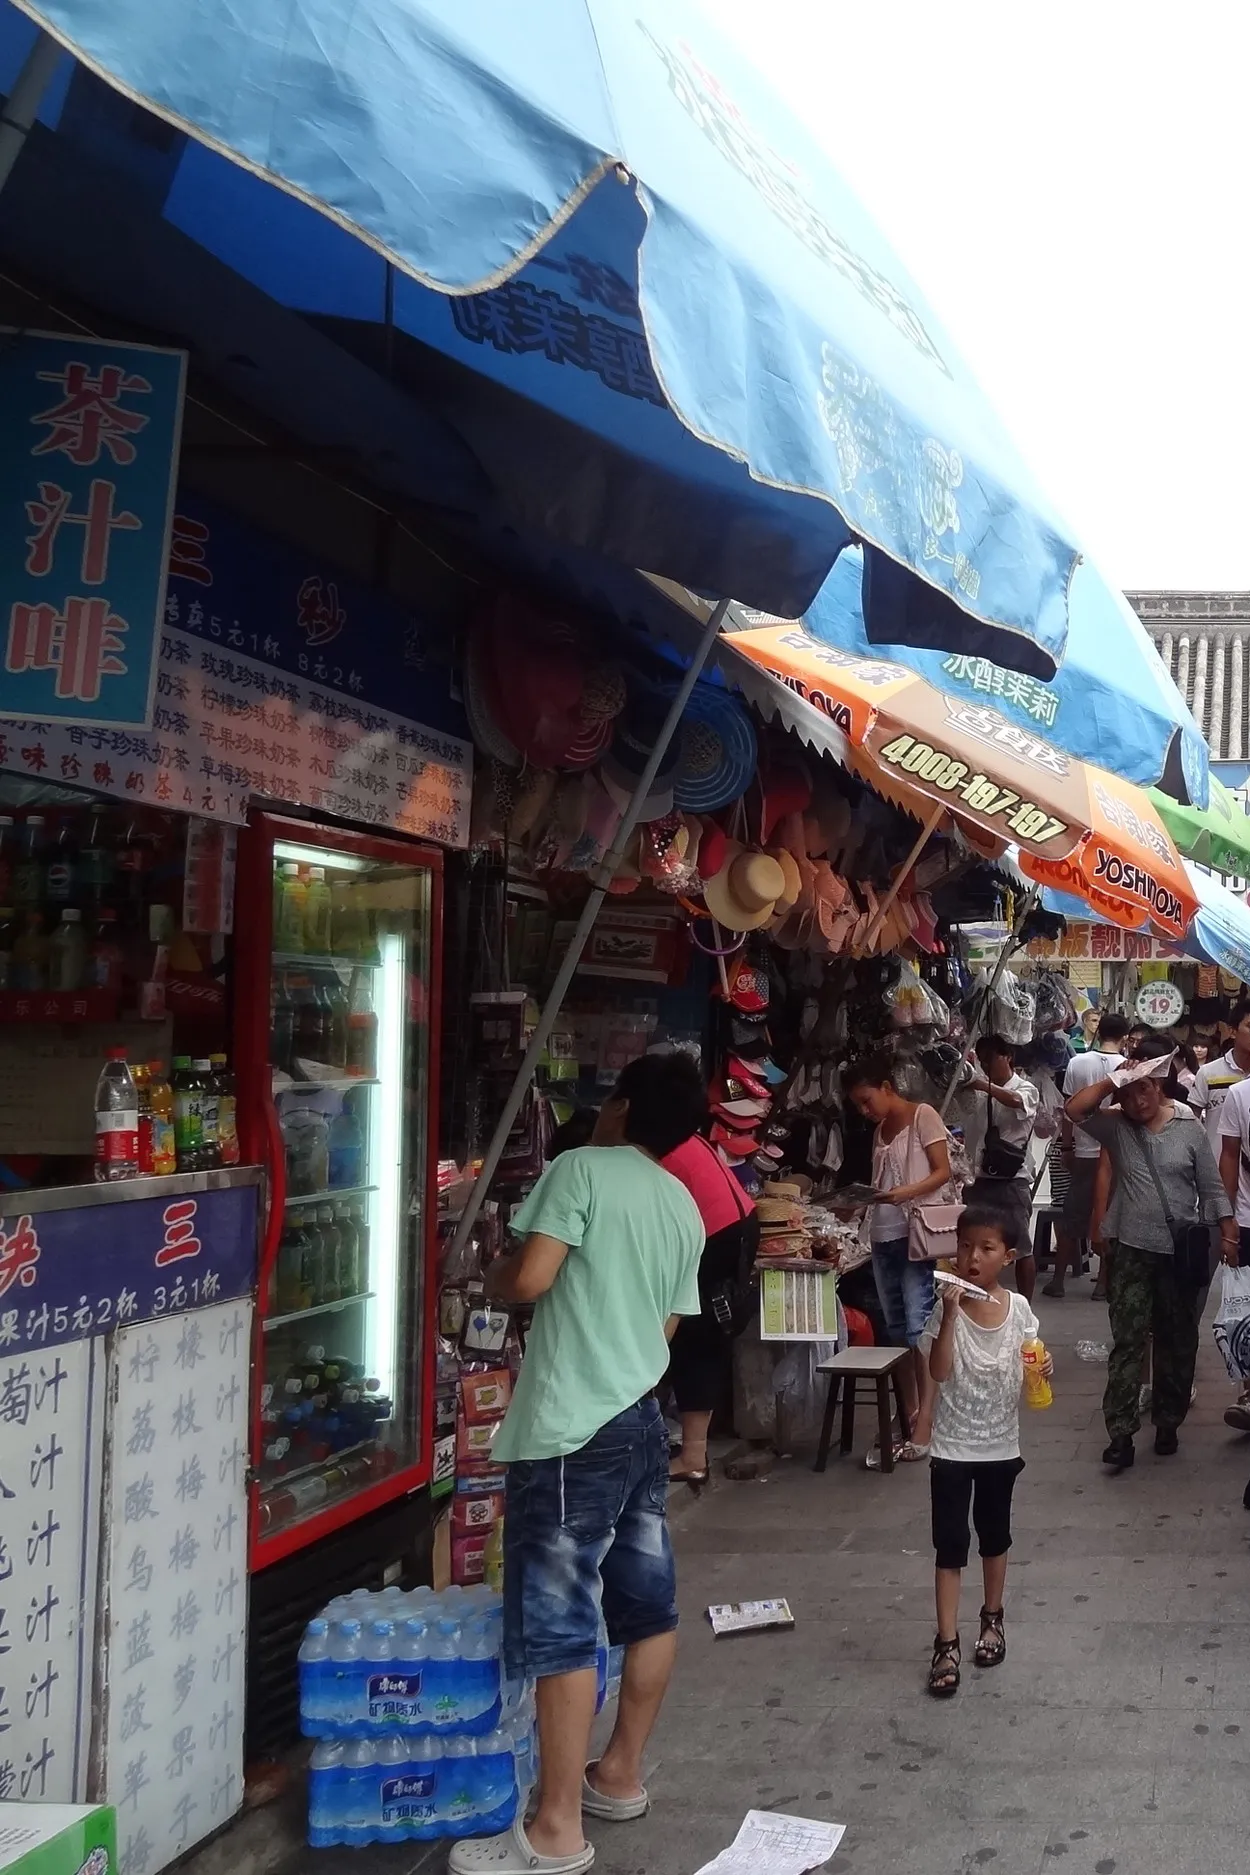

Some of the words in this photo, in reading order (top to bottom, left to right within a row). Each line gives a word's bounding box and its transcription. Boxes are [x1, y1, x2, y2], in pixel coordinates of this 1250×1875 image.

[201, 652, 300, 704] 玫瑰珍珠奶茶
[308, 691, 390, 732] 荔枝珍珠奶茶
[201, 684, 301, 735] 柠檬珍珠奶茶
[200, 719, 301, 767] 苹果珍珠奶茶
[881, 734, 1067, 844] 4008-197-197
[1093, 848, 1184, 931] YOSHINOYA
[1149, 998, 1170, 1014] 19
[153, 1268, 221, 1313] 3元1杯
[128, 1310, 244, 1384] 柠檬汁
[126, 1374, 241, 1457] 荔枝汁
[119, 1633, 238, 1744] 菠萝汁
[368, 1702, 423, 1717] 矿物质水
